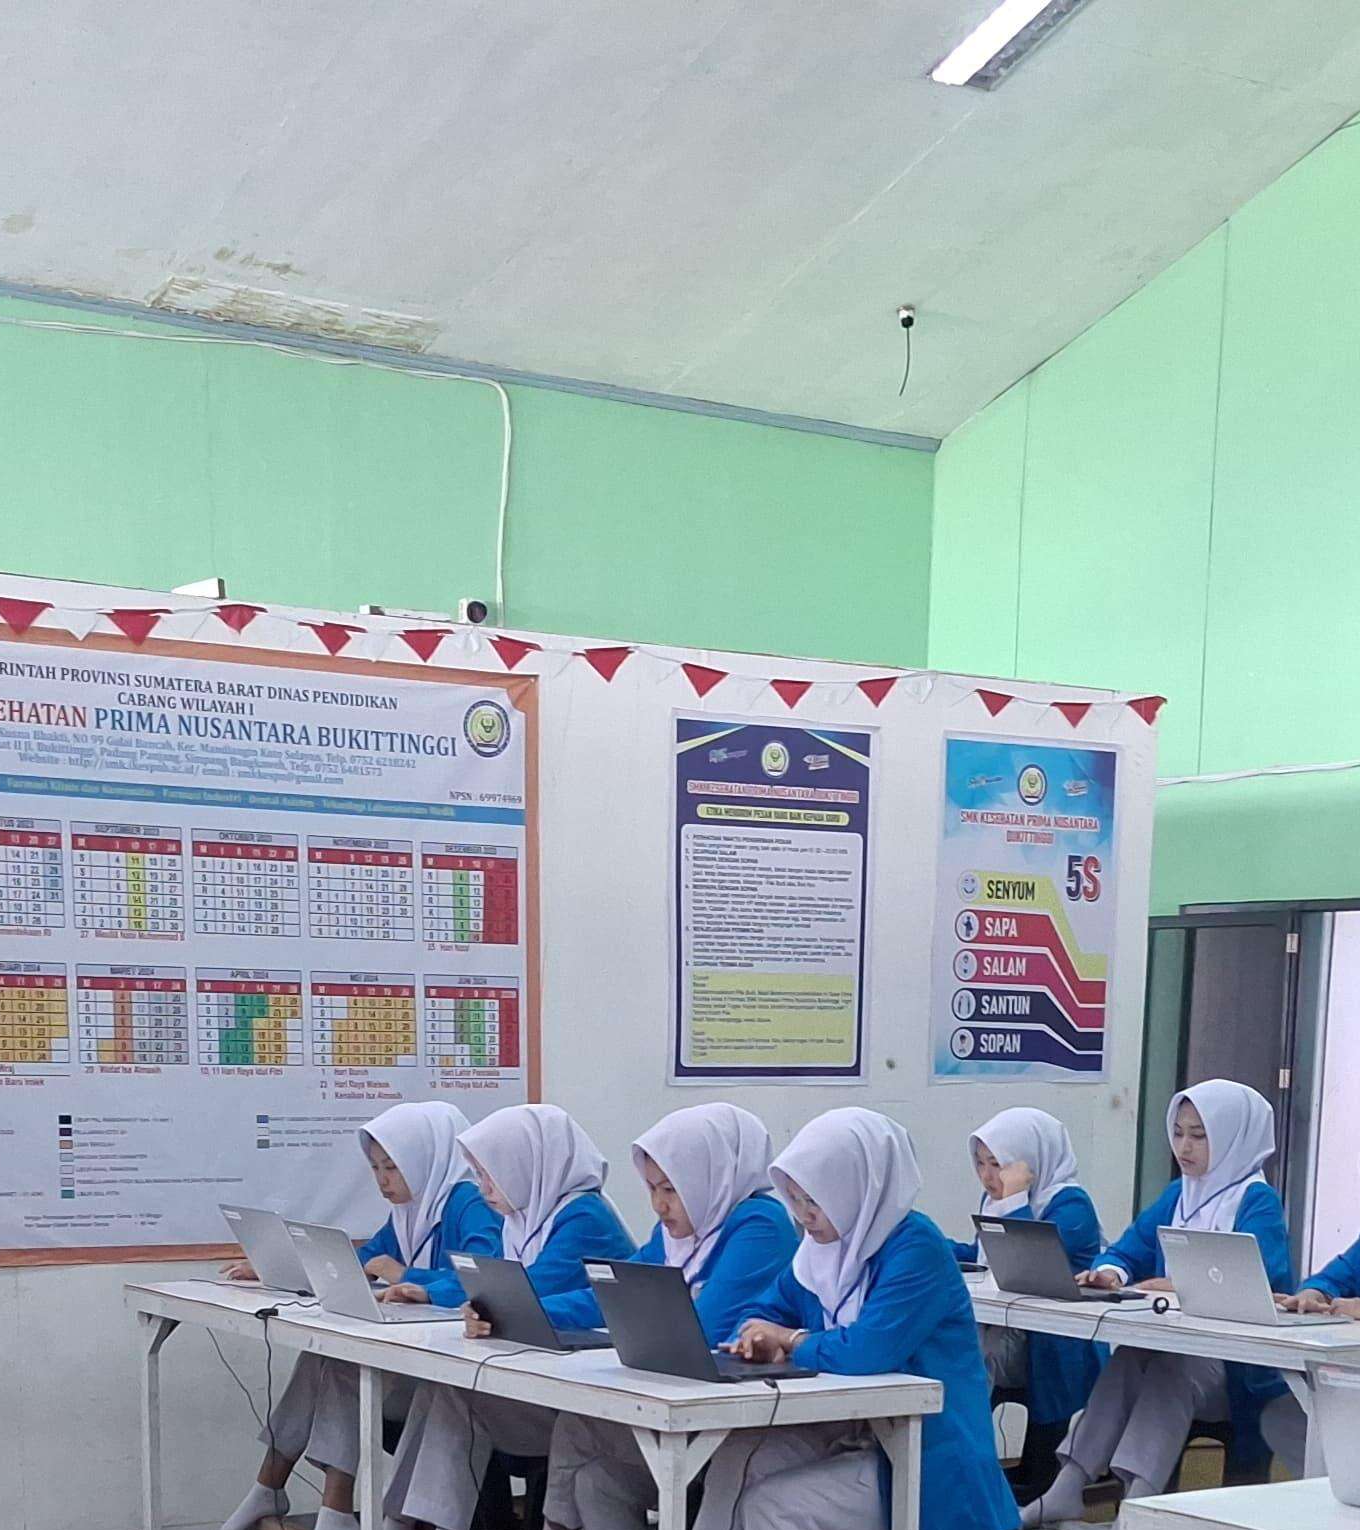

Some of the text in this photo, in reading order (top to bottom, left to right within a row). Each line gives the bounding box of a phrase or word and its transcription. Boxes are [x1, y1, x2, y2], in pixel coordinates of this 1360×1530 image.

[60, 667, 130, 687] PROVINSI
[134, 674, 213, 695] SUMATERA
[217, 681, 264, 698] BARAT
[268, 686, 309, 702] DINAS
[313, 691, 398, 710] PENDIDIKAN
[118, 692, 255, 716] CABANG WILAYAH I
[94, 707, 171, 735] PRIMA
[178, 715, 311, 746] NUSANTARA
[317, 726, 457, 757] BUKITTINGGI
[1065, 854, 1101, 902] 5S
[987, 880, 1035, 901] SENYUM
[984, 917, 1018, 938] SAPA
[983, 957, 1026, 976] SALAM
[980, 995, 1030, 1015] SANTUN
[979, 1032, 1021, 1053] SOPAN
